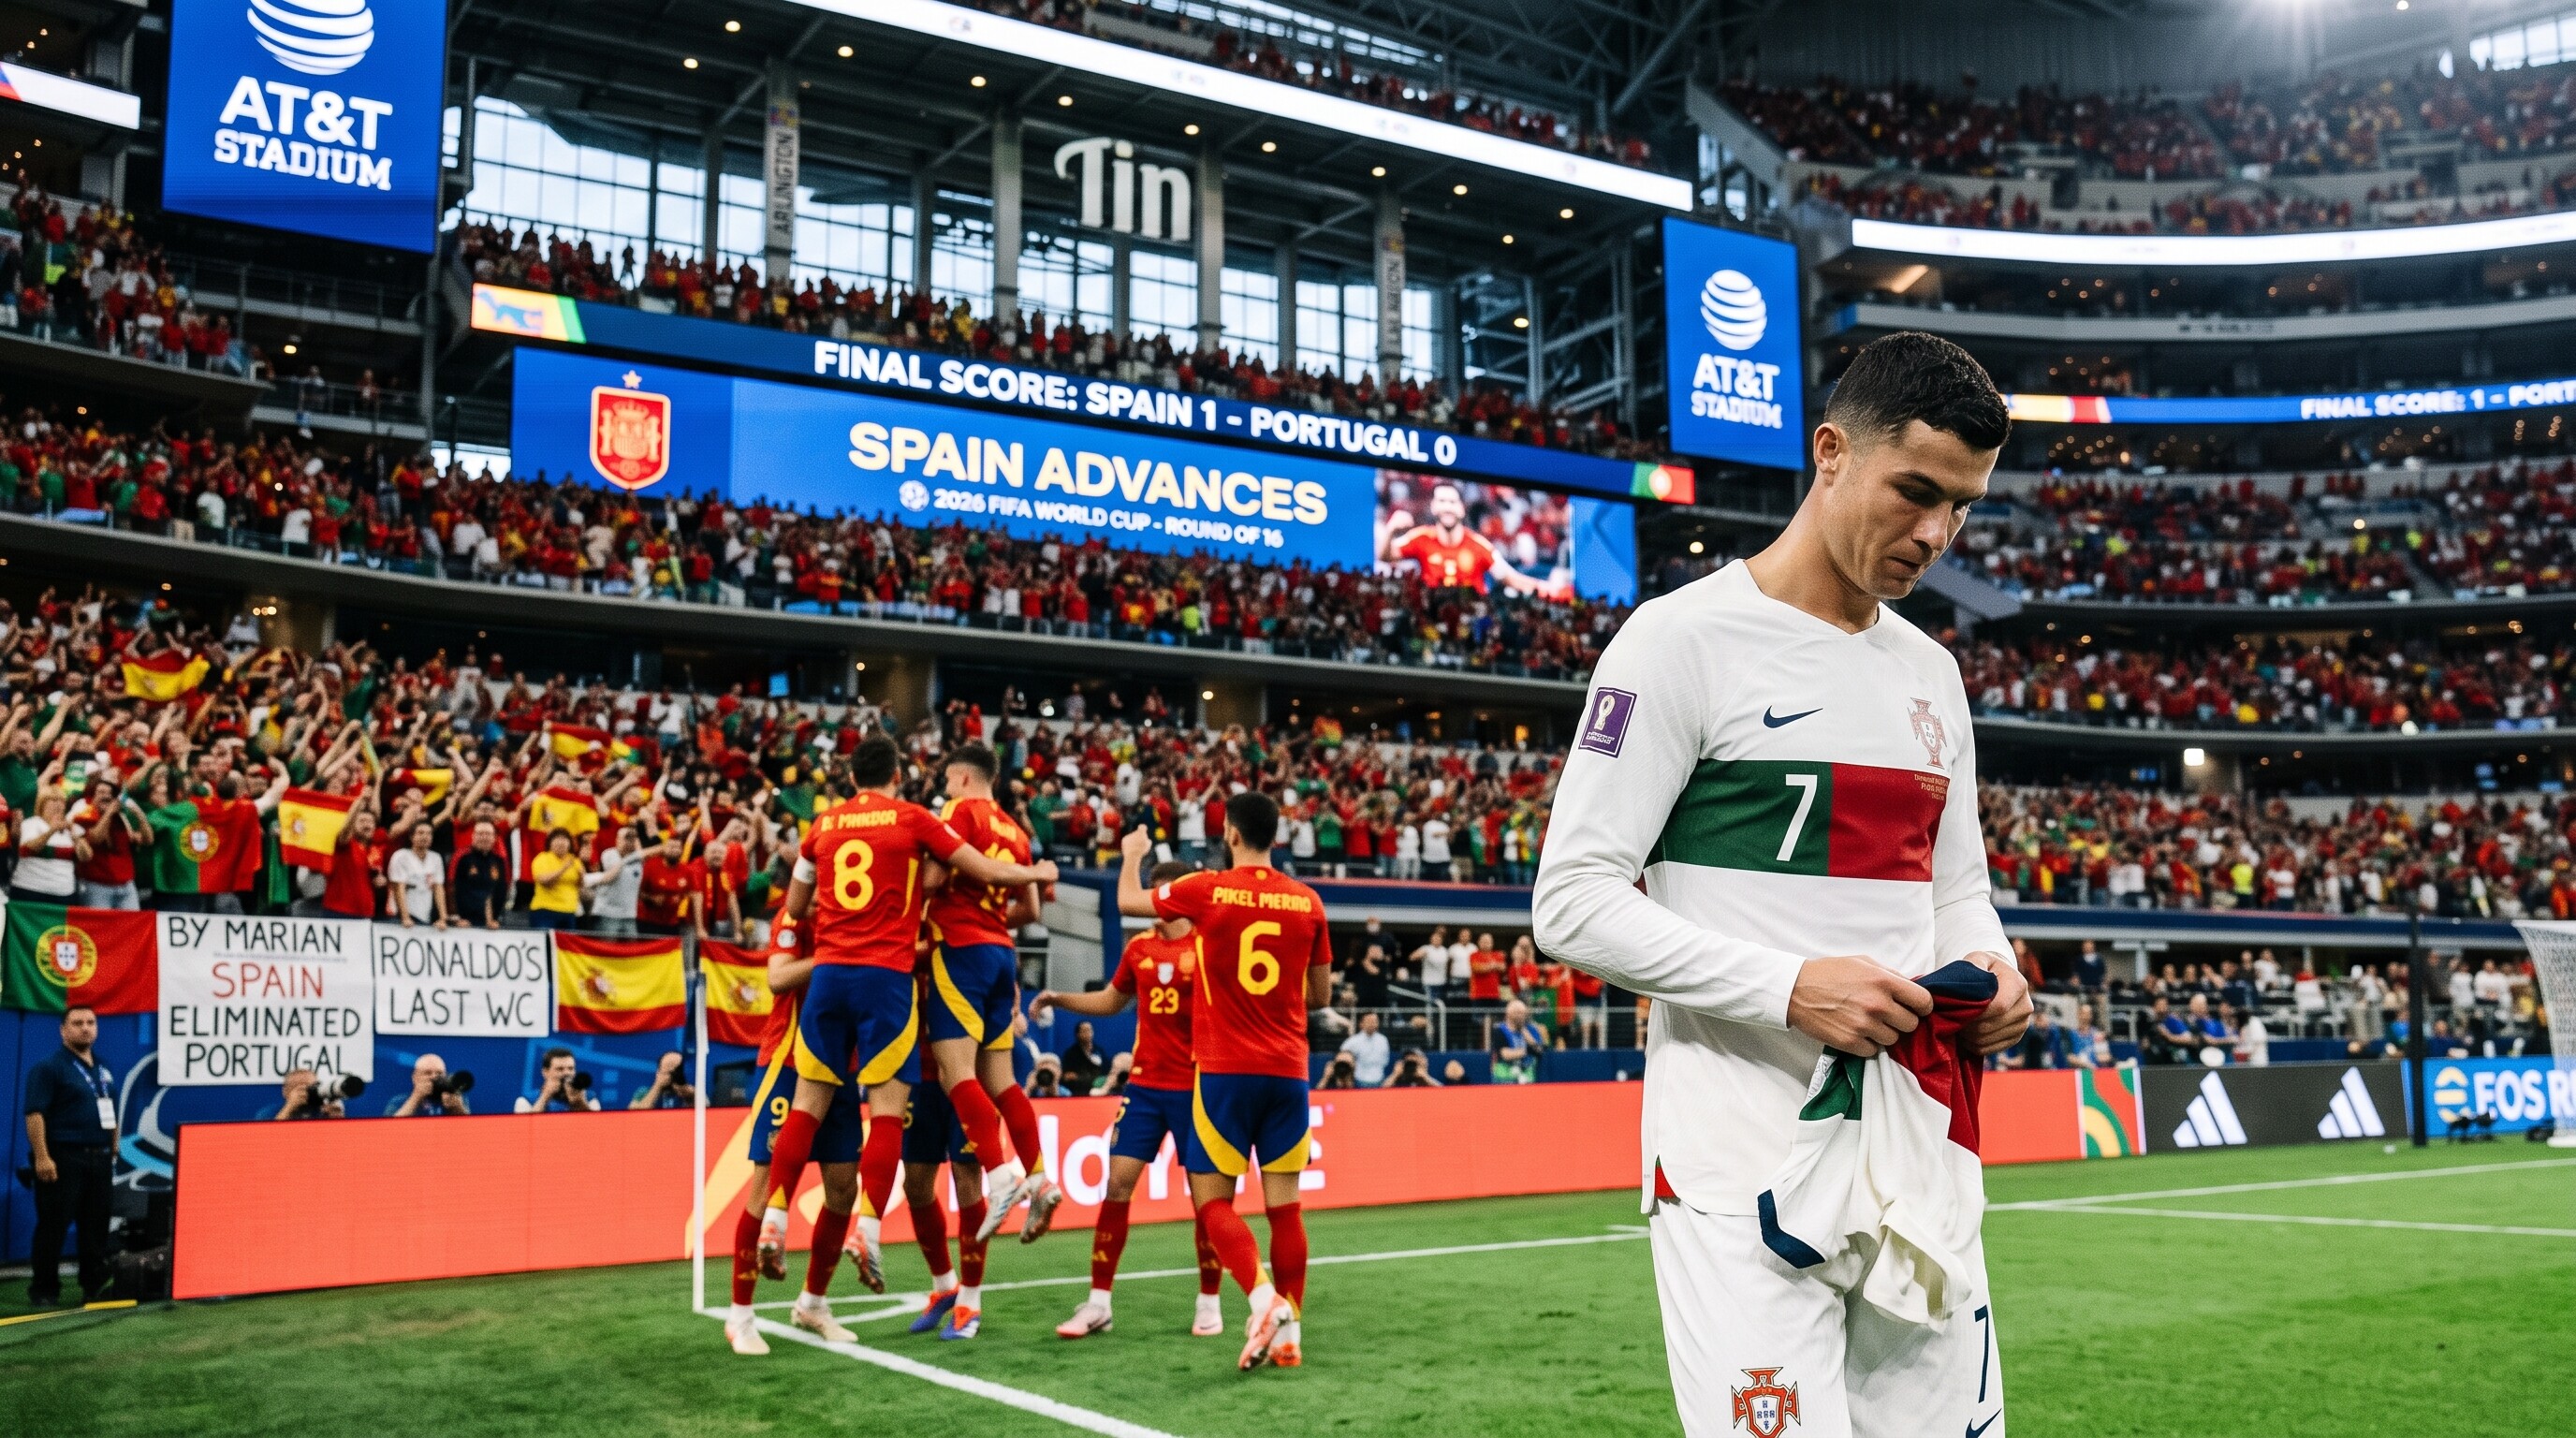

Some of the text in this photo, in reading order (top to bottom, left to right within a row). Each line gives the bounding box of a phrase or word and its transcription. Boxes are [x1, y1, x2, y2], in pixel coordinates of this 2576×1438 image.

[219, 75, 393, 150] AT&T
[214, 128, 392, 191] STADIUM
[1692, 353, 1780, 402] AT&T
[814, 341, 932, 389] FINAL
[939, 360, 1078, 411] SCORE:
[1085, 382, 1193, 429] SPAIN
[1200, 401, 1217, 431] 1
[1250, 405, 1428, 462] PORTUGAL
[1434, 435, 1457, 466] 0
[1690, 390, 1782, 429] STADIUM
[2301, 396, 2373, 419] FINAL
[2374, 390, 2466, 417] SCORE:
[2470, 389, 2485, 409] 1
[848, 421, 1327, 525] SPAIN ADVANCES
[933, 488, 987, 513] 2026
[988, 494, 1033, 519] FIFA
[1034, 500, 1107, 528] WORLD
[1109, 509, 1151, 532] CUP
[1164, 517, 1233, 542] ROUND
[1234, 524, 1261, 545] OF
[1262, 528, 1284, 549] 16
[1776, 773, 1818, 862] 7
[834, 839, 873, 911] 8
[168, 917, 342, 953] BY MARIAN
[380, 936, 543, 981] RONALDO'S
[1237, 920, 1281, 995] 6
[212, 961, 324, 999] SPAIN
[1149, 988, 1178, 1014] 23
[170, 1005, 361, 1037] ELIMINATED
[390, 988, 534, 1027] LAST WC
[184, 1043, 345, 1078] PORTUGAL
[770, 1096, 790, 1127] 9
[1973, 1304, 1989, 1404] 7
